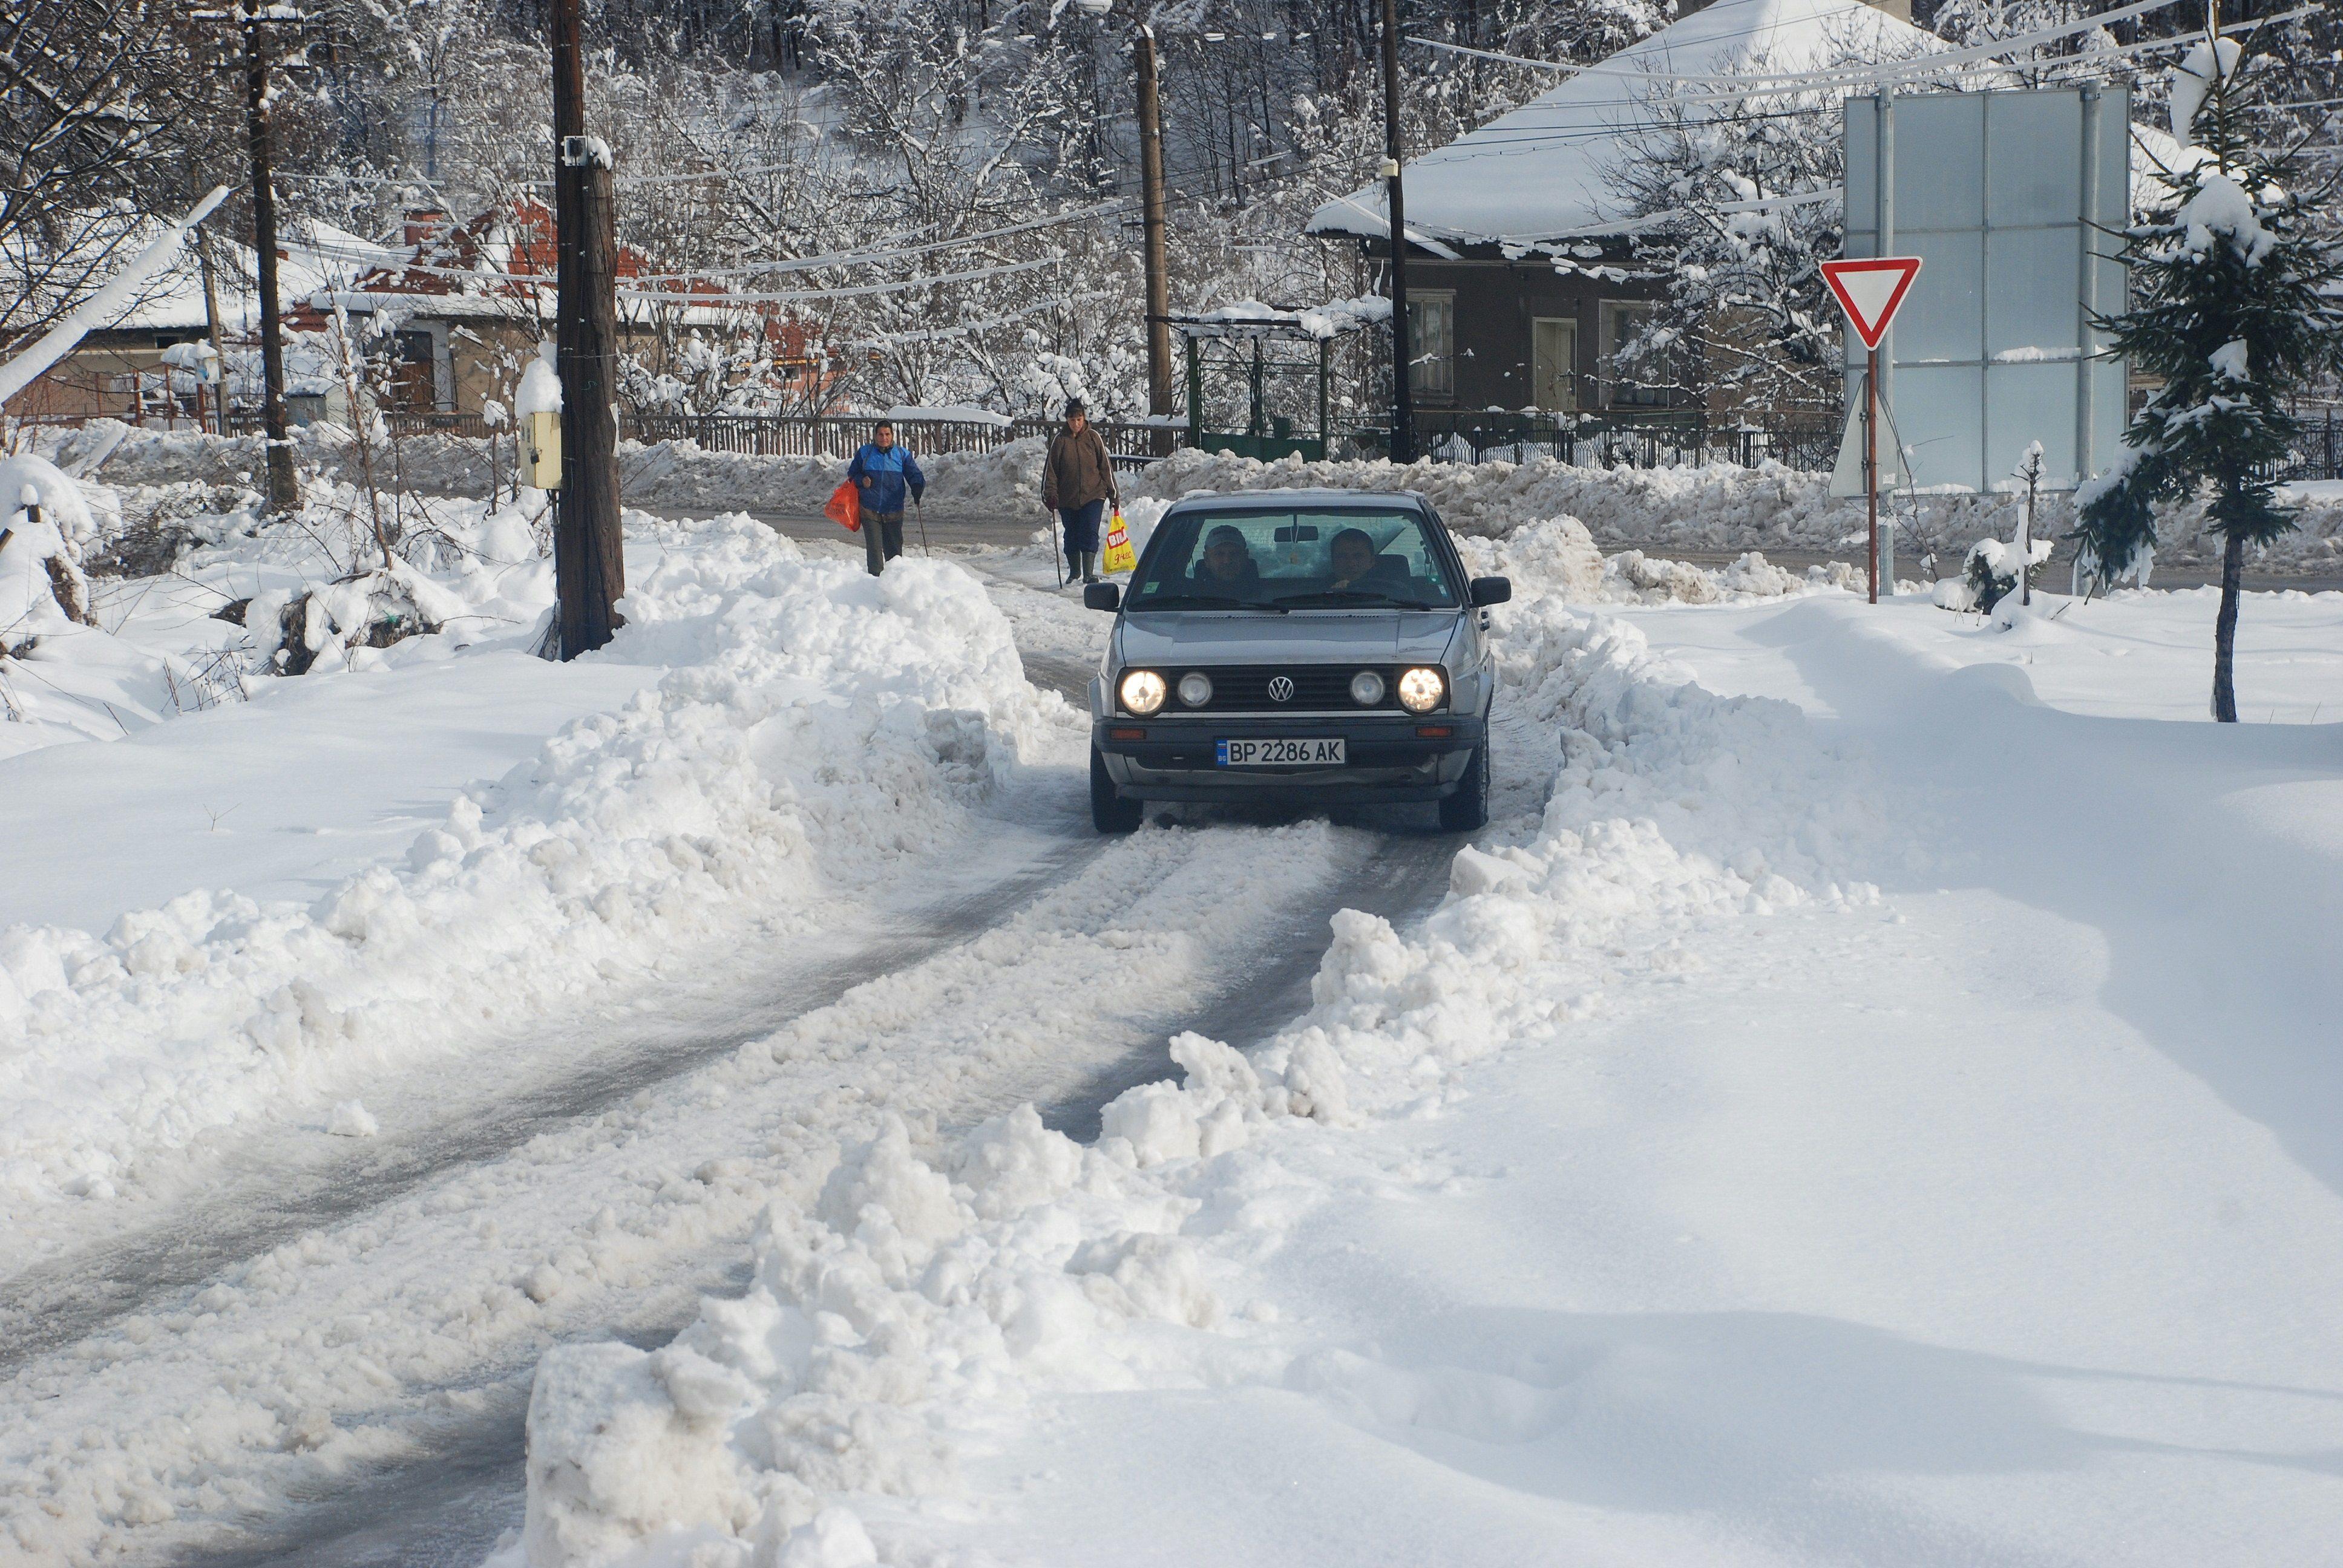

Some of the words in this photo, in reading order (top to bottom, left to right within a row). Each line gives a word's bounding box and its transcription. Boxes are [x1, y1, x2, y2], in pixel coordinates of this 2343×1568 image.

[1268, 676, 1294, 702] VW
[1230, 743, 1257, 762] BP
[1261, 741, 1311, 762] 2286
[1315, 742, 1341, 761] AK
